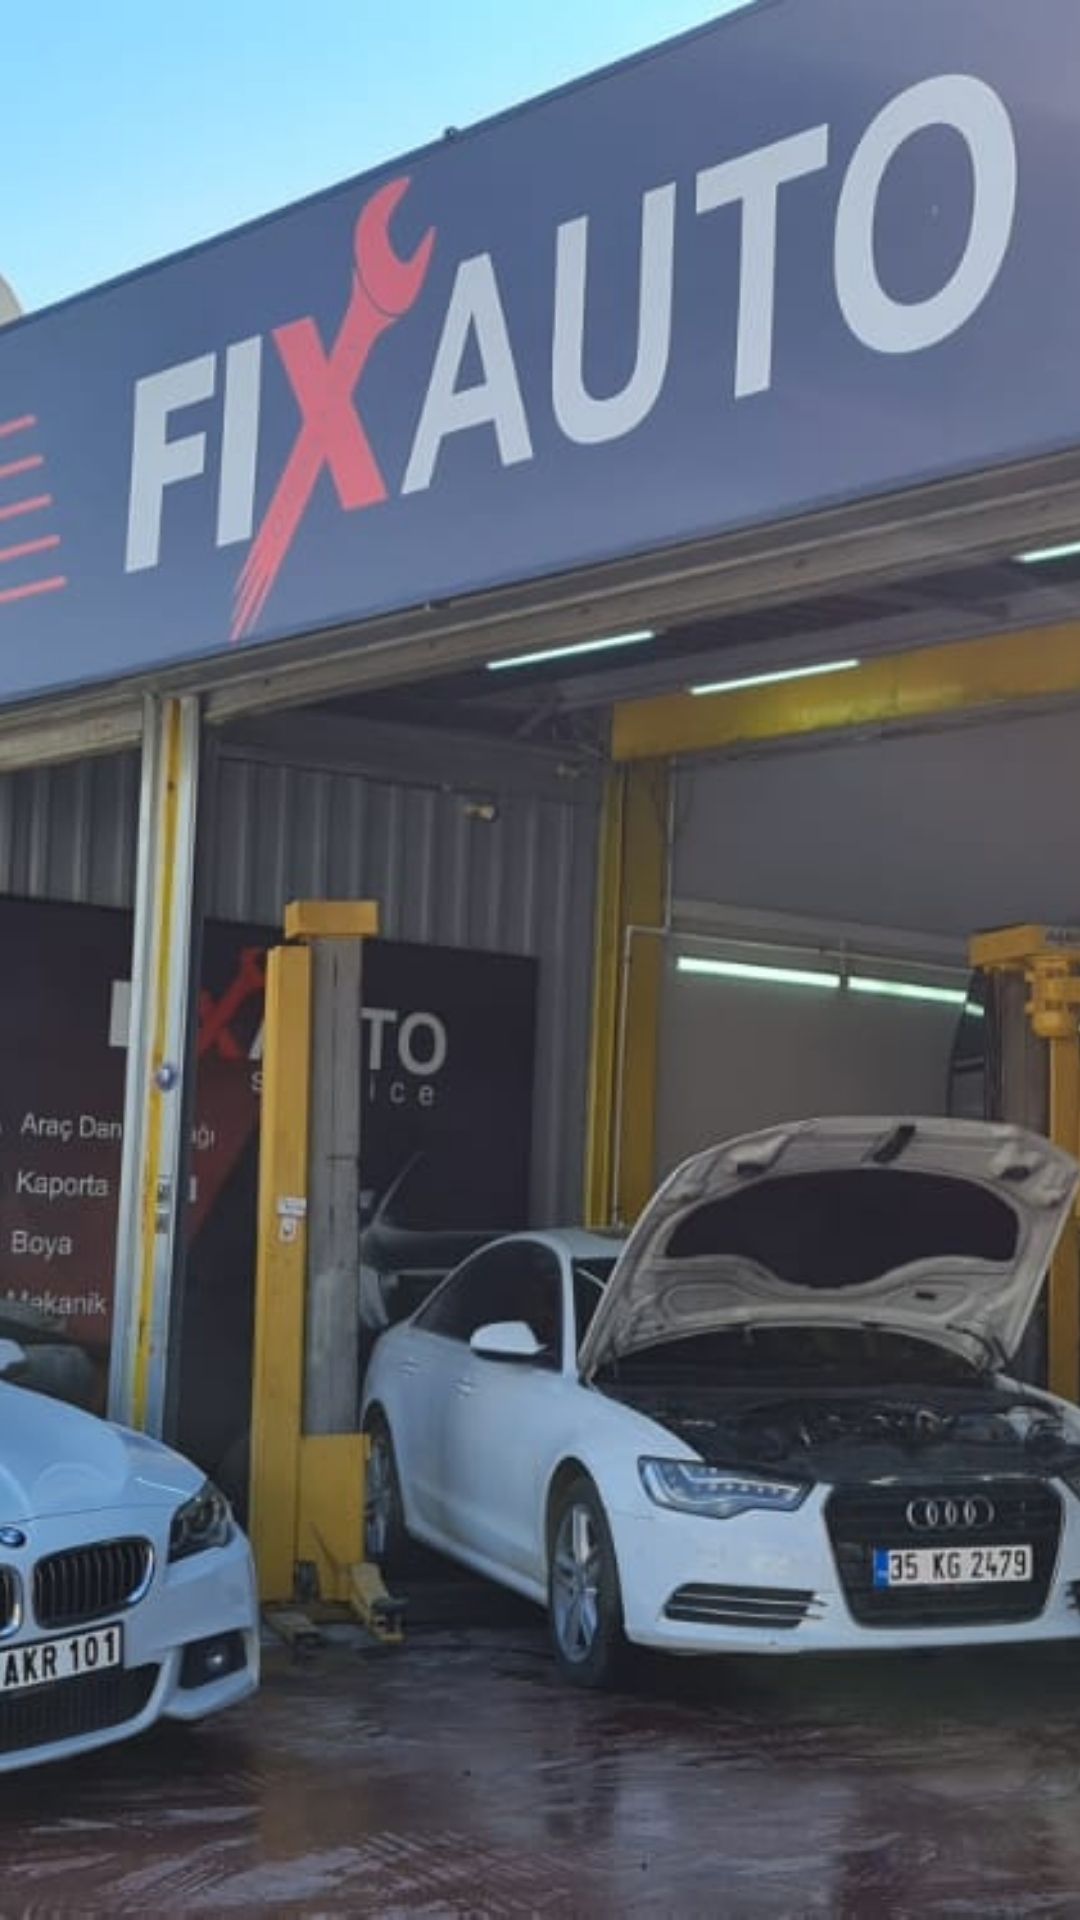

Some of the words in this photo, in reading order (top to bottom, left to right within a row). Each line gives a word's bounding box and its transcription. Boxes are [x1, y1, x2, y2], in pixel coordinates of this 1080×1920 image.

[20, 1112, 73, 1142] Araç
[16, 1170, 109, 1203] Kaporta
[11, 1229, 73, 1262] Boya
[890, 1553, 918, 1581] 35
[931, 1552, 961, 1579] KG
[970, 1549, 1026, 1579] 2479
[4, 1645, 58, 1687] AKR
[69, 1631, 115, 1672] 101
